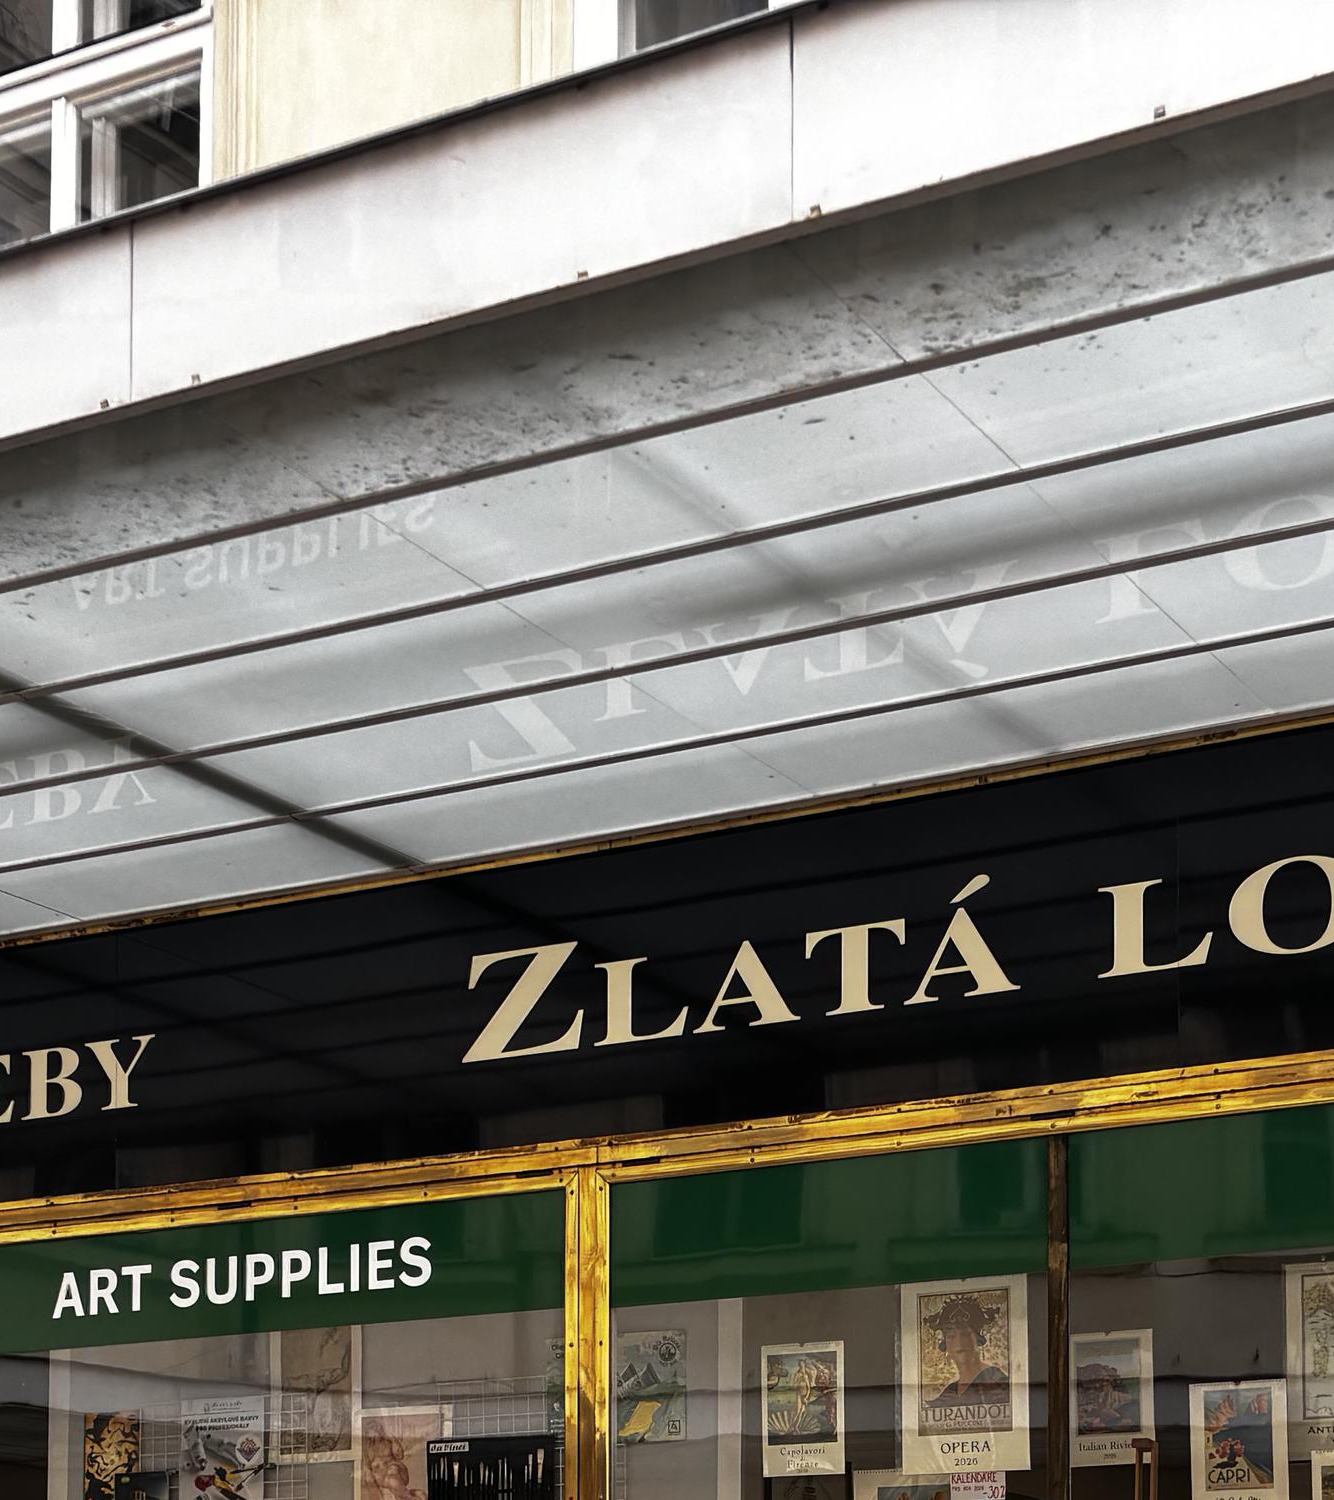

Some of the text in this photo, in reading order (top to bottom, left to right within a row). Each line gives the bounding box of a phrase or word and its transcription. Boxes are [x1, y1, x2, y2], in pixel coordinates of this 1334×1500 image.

[462, 873, 1020, 1064] ZLATÁ
[51, 1235, 433, 1320] ART SUPPLIES
[922, 1403, 1010, 1424] TURANDOT
[780, 1445, 826, 1458] Capolavori
[940, 1440, 991, 1456] OPERA
[1078, 1442, 1107, 1452] Italian
[954, 1457, 979, 1467] 2026
[1208, 1468, 1250, 1485] CAPRI
